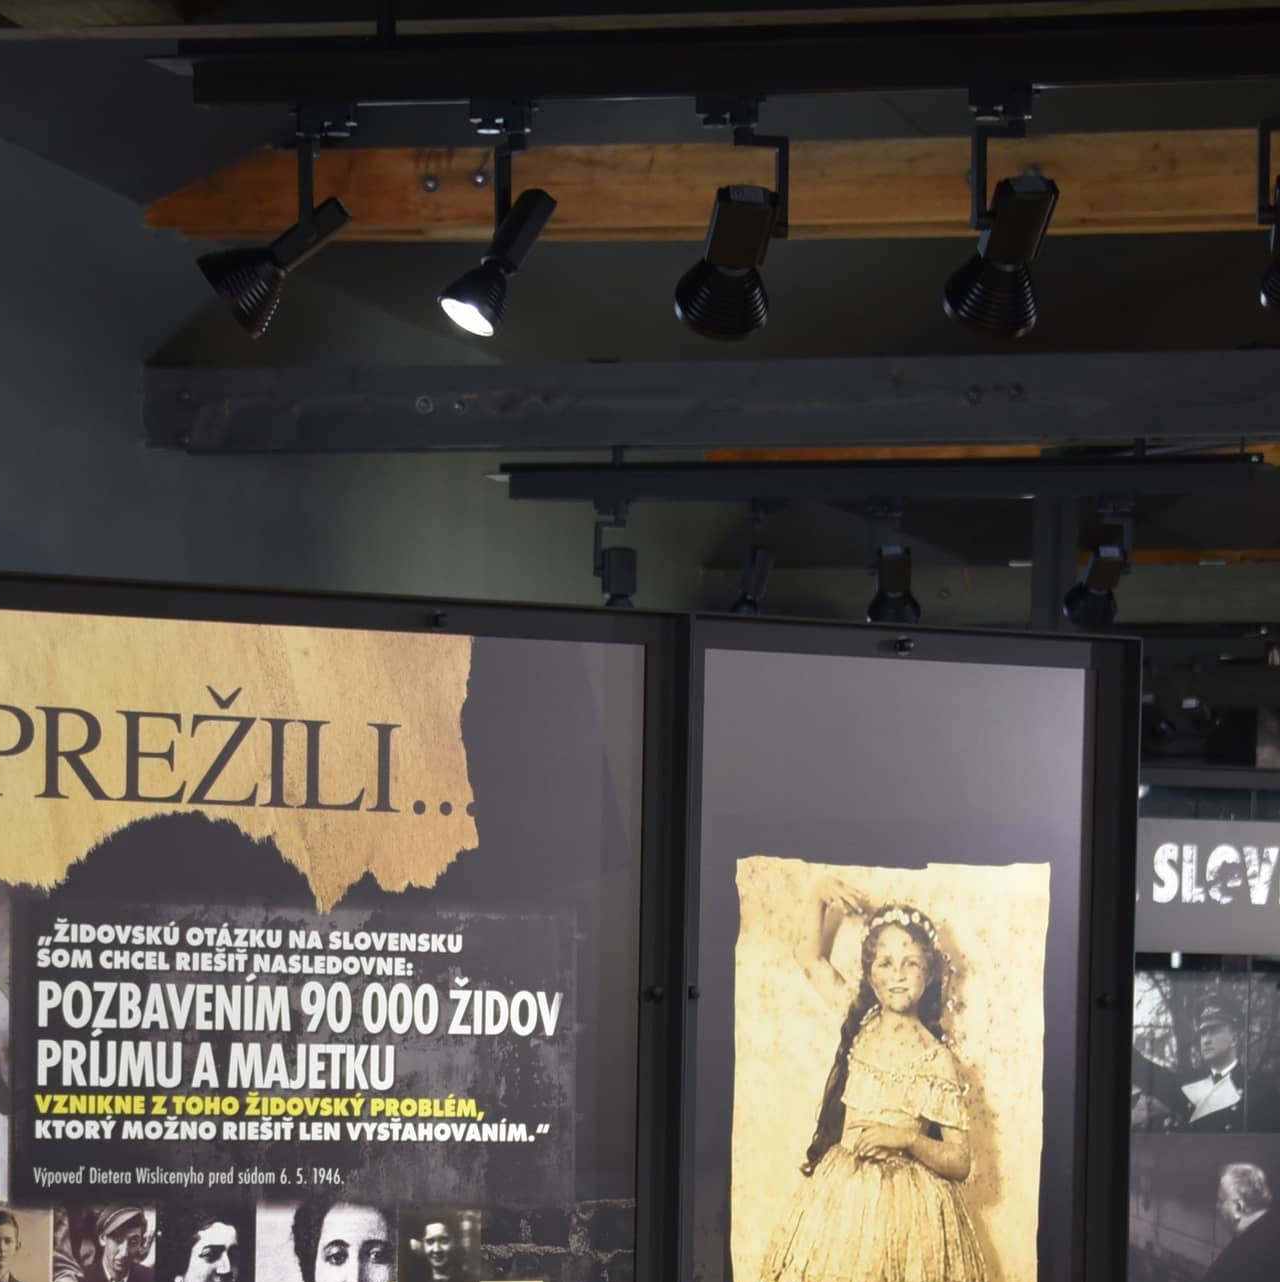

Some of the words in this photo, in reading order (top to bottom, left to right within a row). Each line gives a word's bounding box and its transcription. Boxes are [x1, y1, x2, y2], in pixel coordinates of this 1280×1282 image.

[185, 922, 282, 948] OTÁZKU
[289, 930, 323, 949] NA
[329, 931, 463, 953] SLOVENSKU
[37, 948, 93, 969] SOM
[99, 950, 170, 970] CHCEL
[176, 947, 248, 972] RIEŠIŤ
[253, 953, 413, 977] NASLEDOVNE:
[36, 972, 292, 1033] POZBAVENÍM
[300, 980, 351, 1035] 90
[362, 981, 439, 1035] 000
[448, 976, 564, 1038] ŽIDOV
[35, 1029, 182, 1089] PRÍJMU
[192, 1042, 220, 1090] A
[227, 1043, 395, 1092] MAJETKU
[33, 1094, 146, 1115] VZNIKNE
[151, 1095, 167, 1115] Z
[172, 1096, 240, 1116] TOHO
[245, 1091, 365, 1117] ŽIDOVSKÝ
[370, 1093, 485, 1121] PROBLÉM,
[34, 1115, 116, 1140] KTORÝ
[122, 1115, 217, 1141] MOŽNO
[223, 1116, 294, 1141] RIEŠIŤ
[299, 1122, 340, 1141] LEN
[33, 1166, 86, 1188] Výpoveď
[89, 1167, 132, 1185] Dietera
[135, 1166, 204, 1188] Wislicenyho
[208, 1166, 234, 1188] pred
[238, 1166, 276, 1185] súdom
[280, 1168, 292, 1185] 6.
[296, 1168, 308, 1185] 5.
[312, 1167, 345, 1185] 1946.
